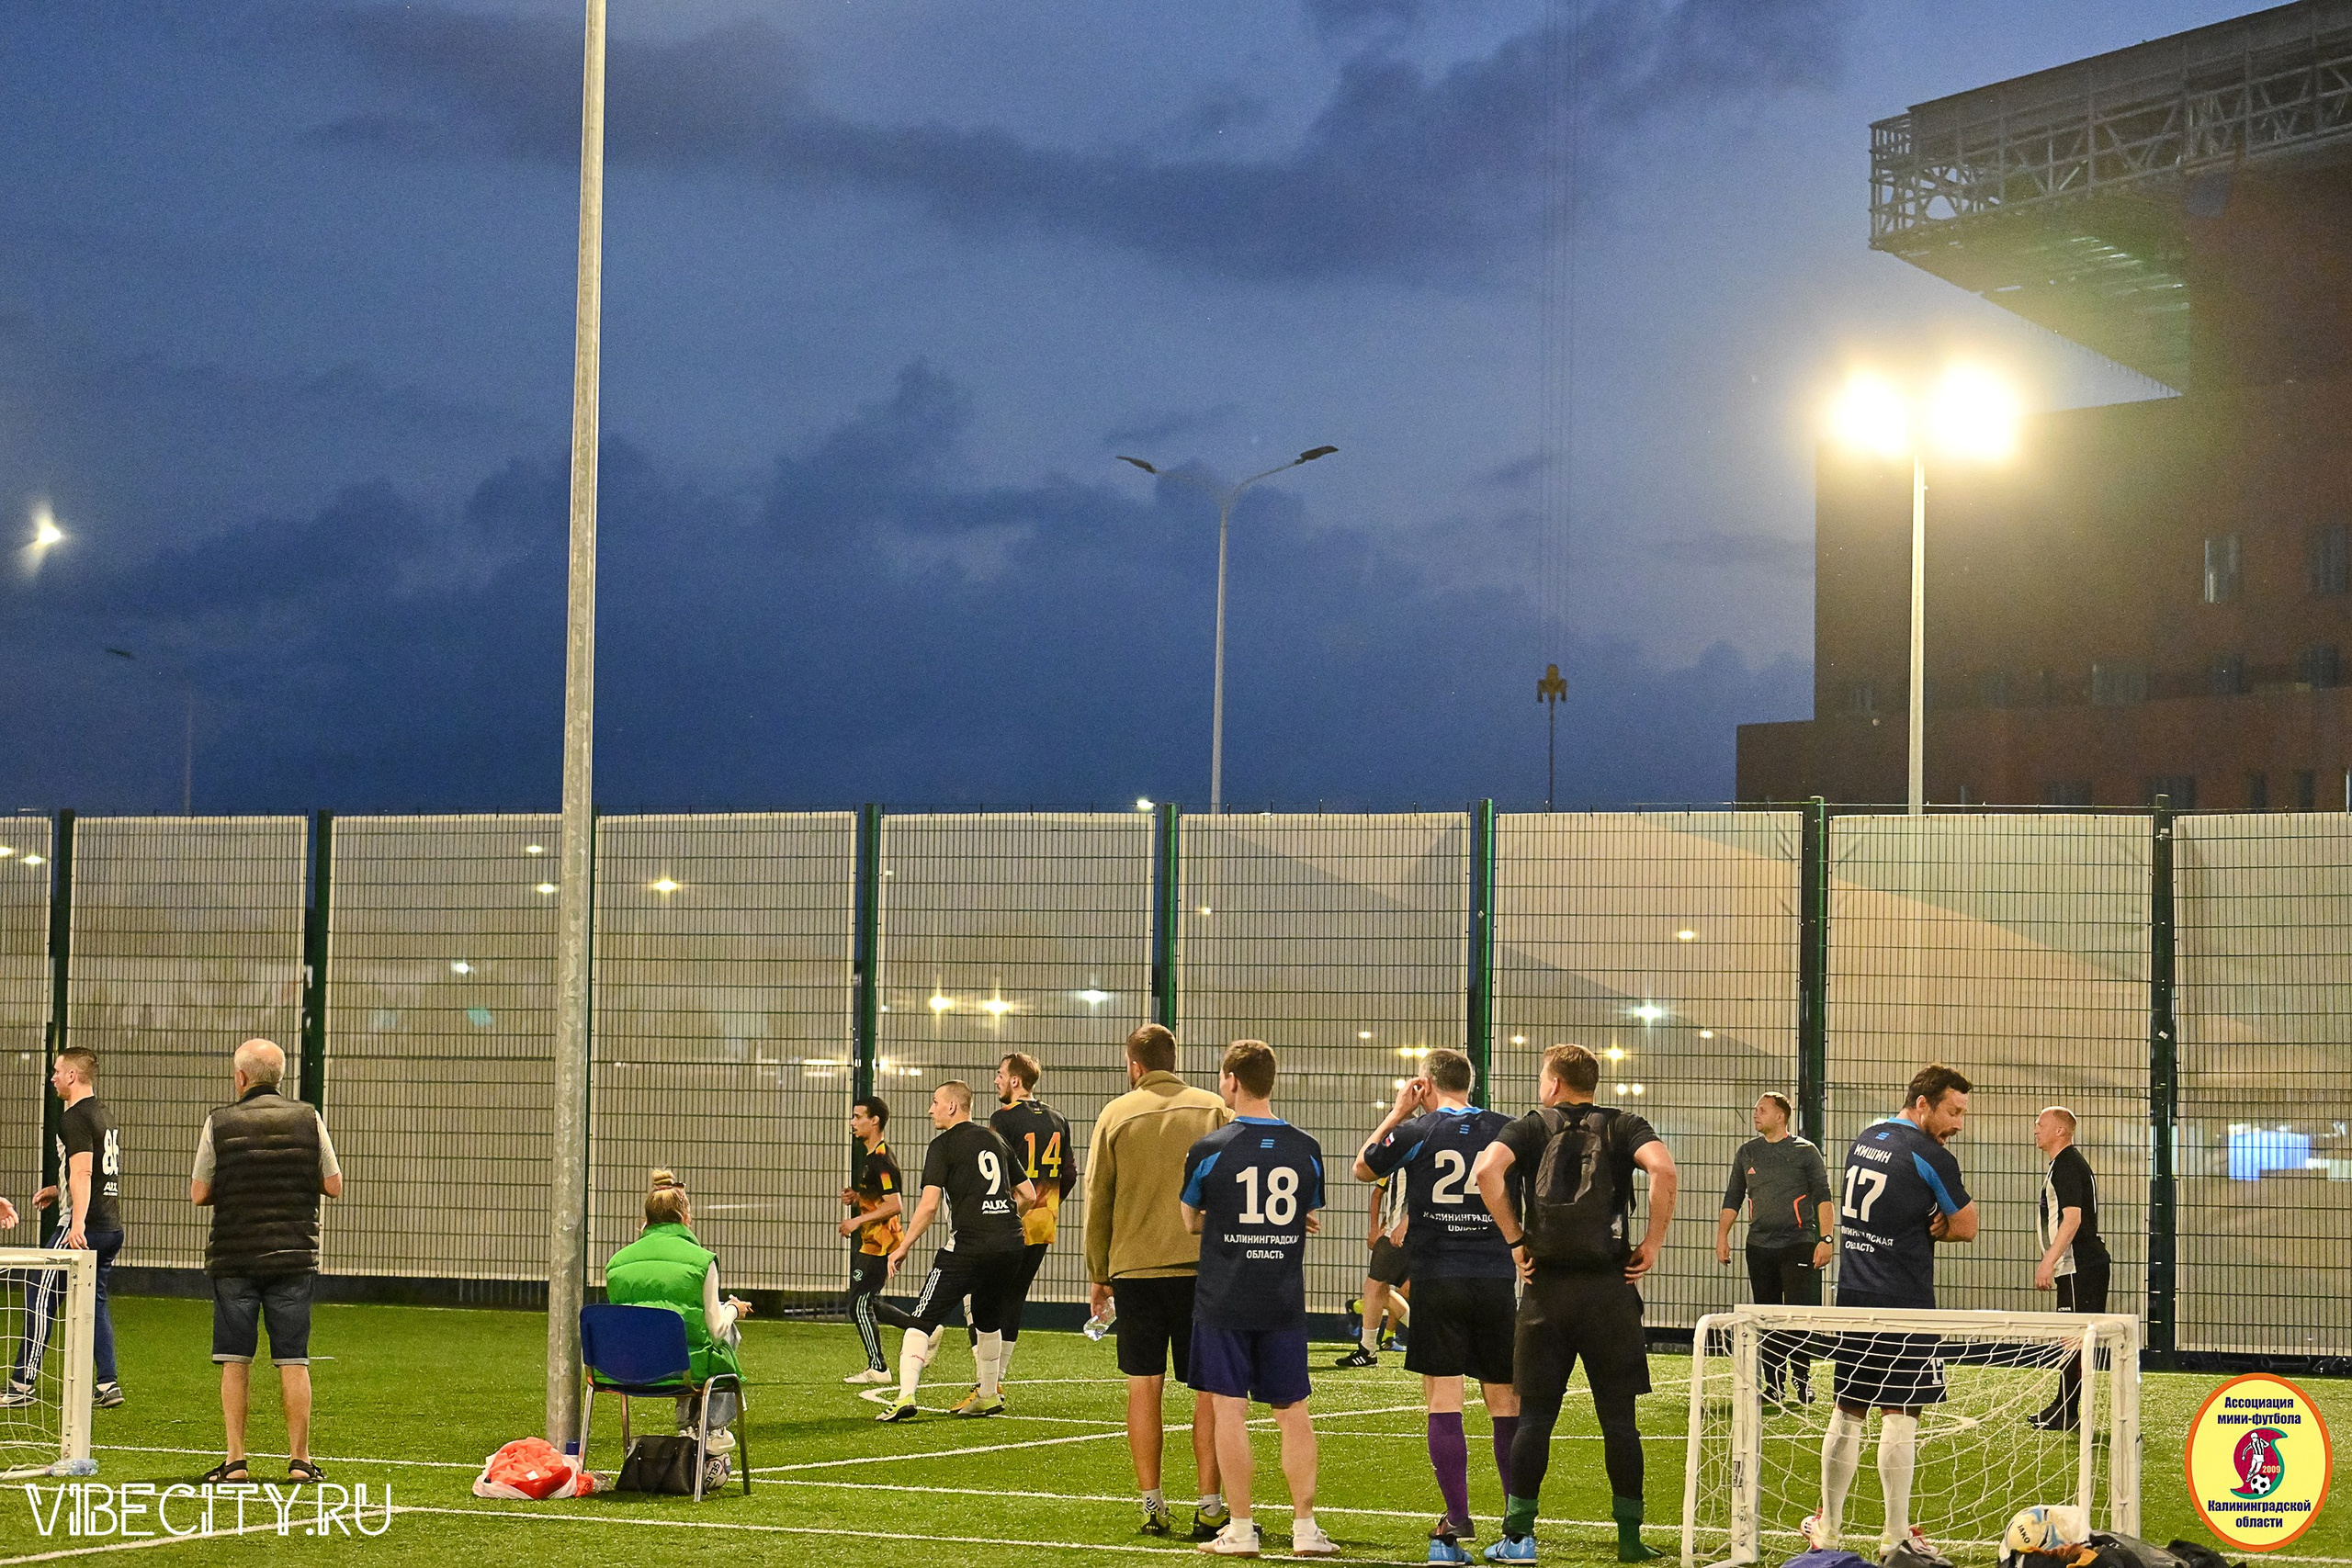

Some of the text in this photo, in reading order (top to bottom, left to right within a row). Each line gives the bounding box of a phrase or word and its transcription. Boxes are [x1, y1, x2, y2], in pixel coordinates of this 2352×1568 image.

[978, 1150, 1001, 1195] 9
[1024, 1132, 1061, 1178] 14
[981, 1199, 1009, 1210] AUX
[1236, 1166, 1299, 1225] 18
[1842, 1165, 1888, 1222] 17
[1246, 1249, 1284, 1259] ОБЛАСТЬ
[2017, 1525, 2030, 1544] JAKO
